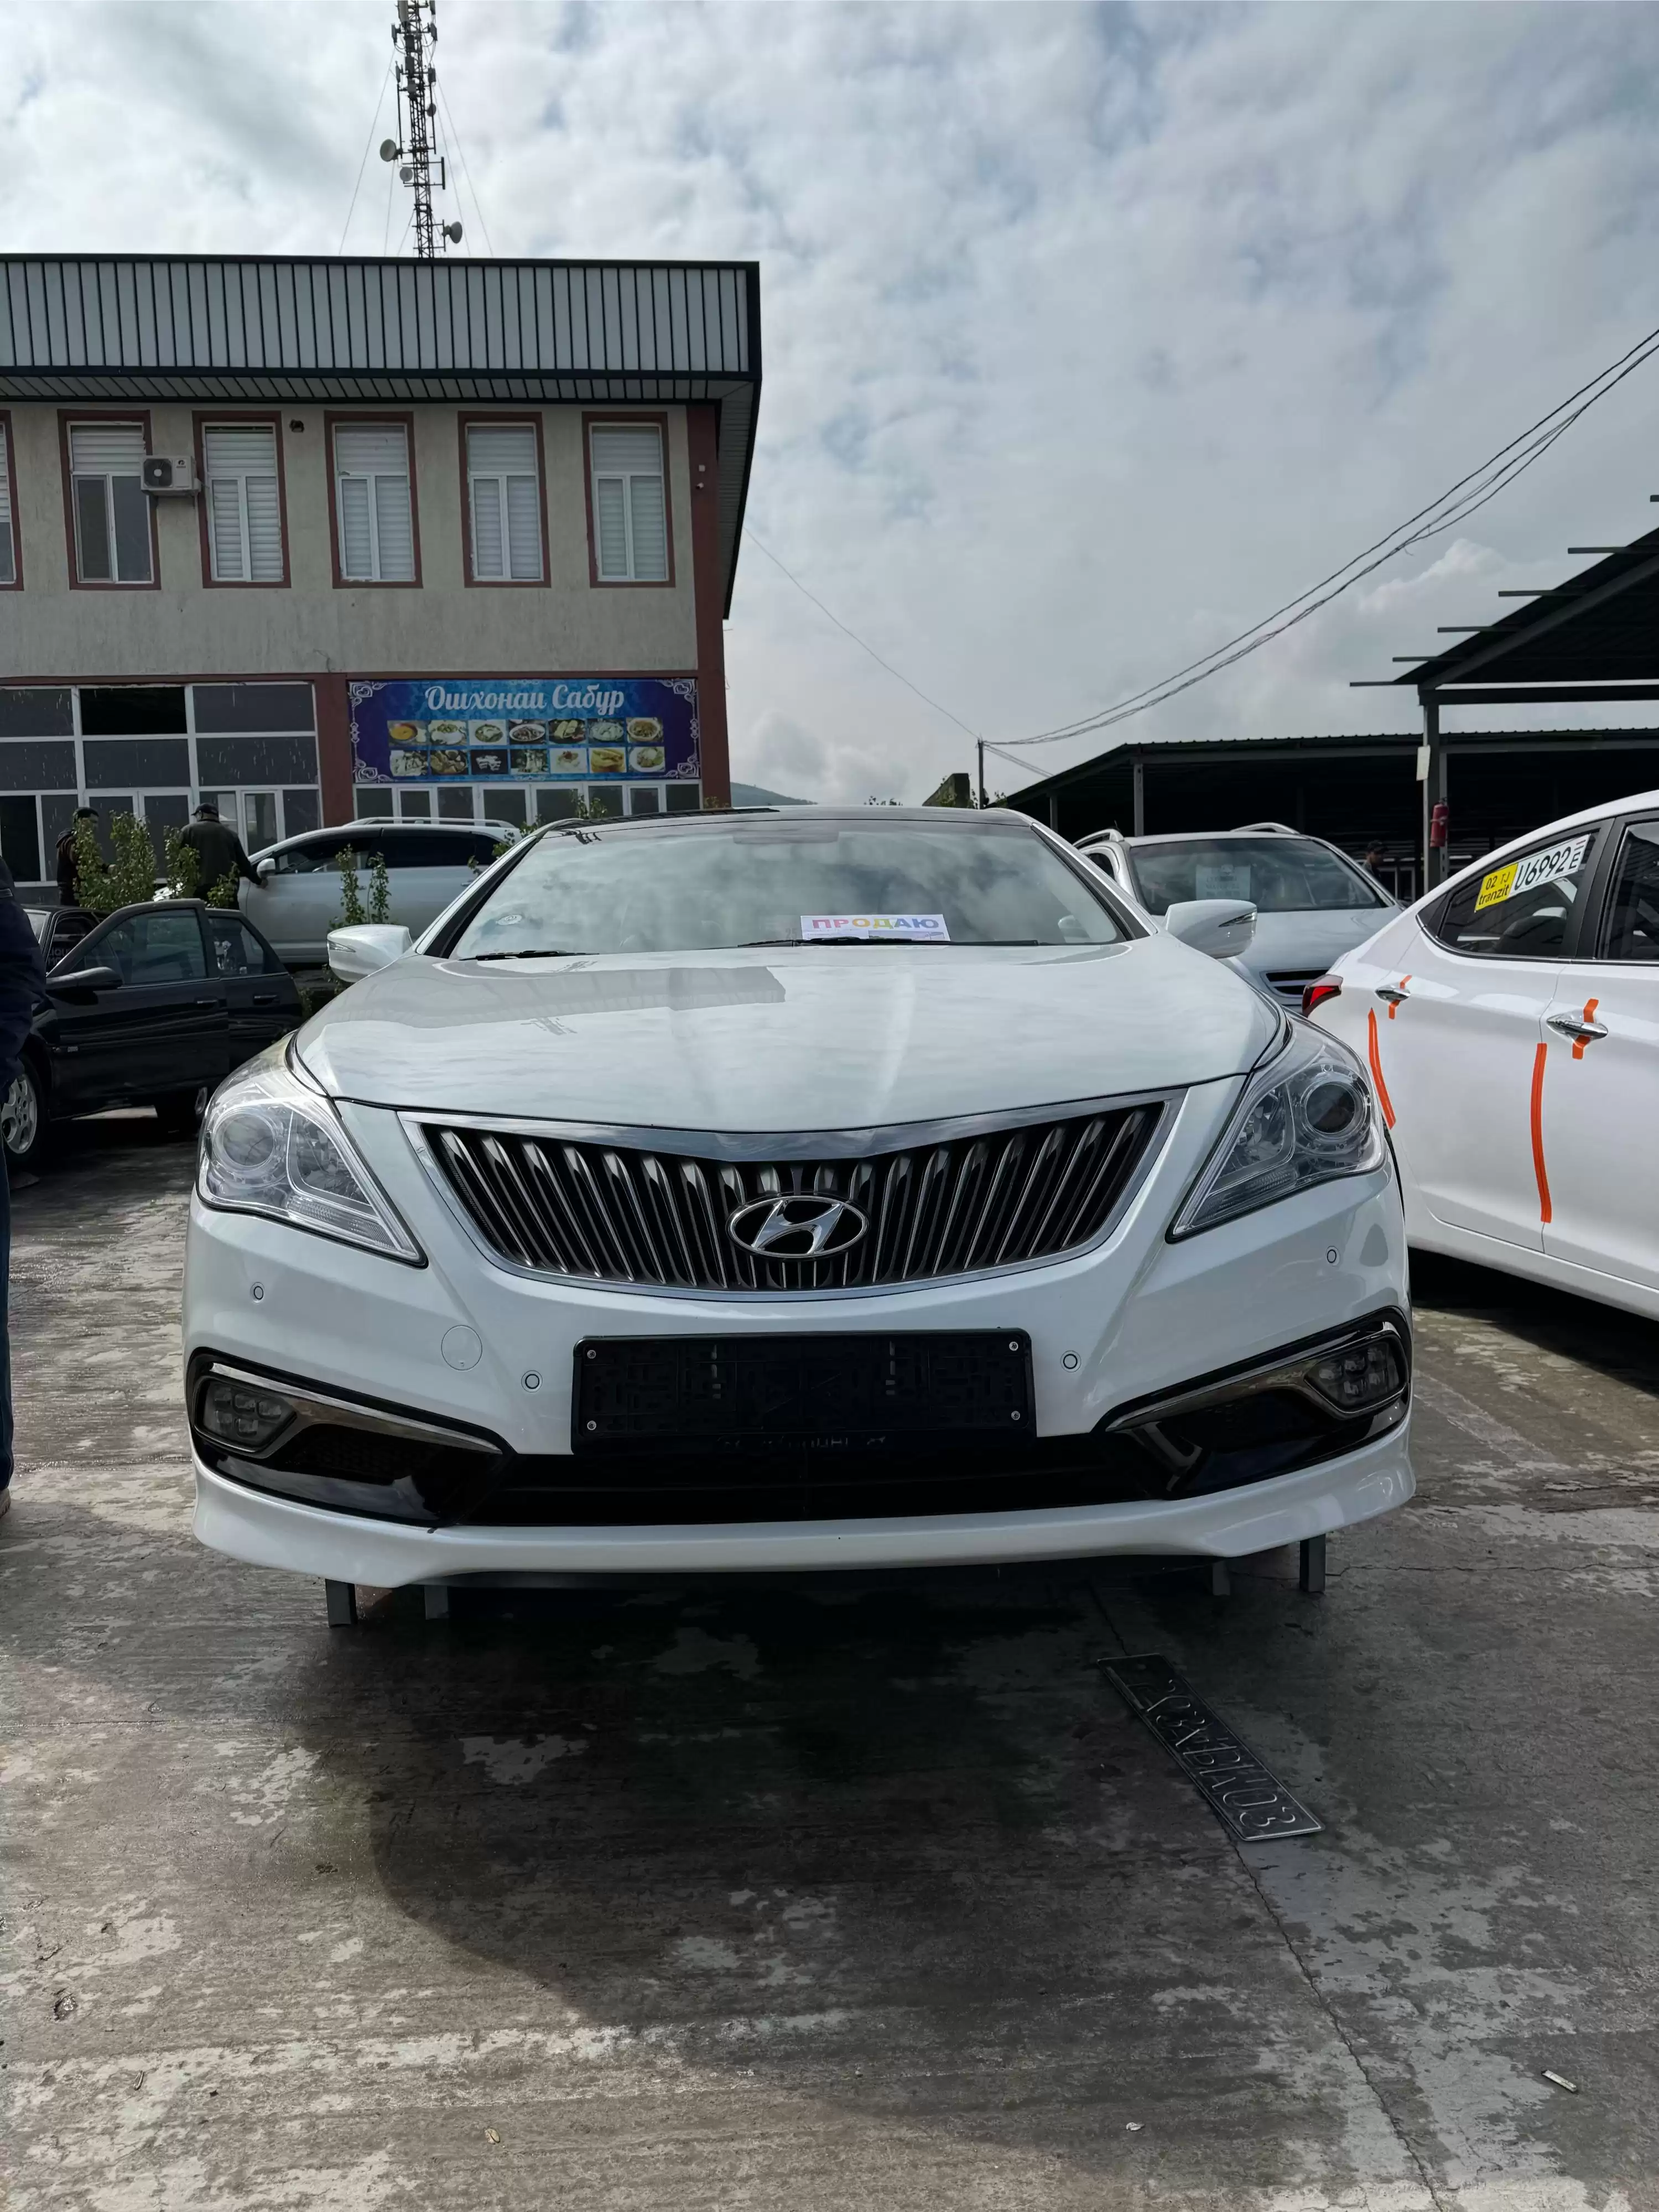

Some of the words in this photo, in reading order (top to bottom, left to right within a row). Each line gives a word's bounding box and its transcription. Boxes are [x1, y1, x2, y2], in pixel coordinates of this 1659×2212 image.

[425, 685, 547, 710] Ошхонаи
[552, 684, 625, 715] Сабур
[1514, 846, 1571, 891] U6992
[1568, 851, 1580, 870] E
[1485, 875, 1498, 891] 02
[1500, 872, 1510, 888] TJ
[1478, 883, 1510, 906] tranzit
[812, 918, 939, 929] ПРОДАЮ
